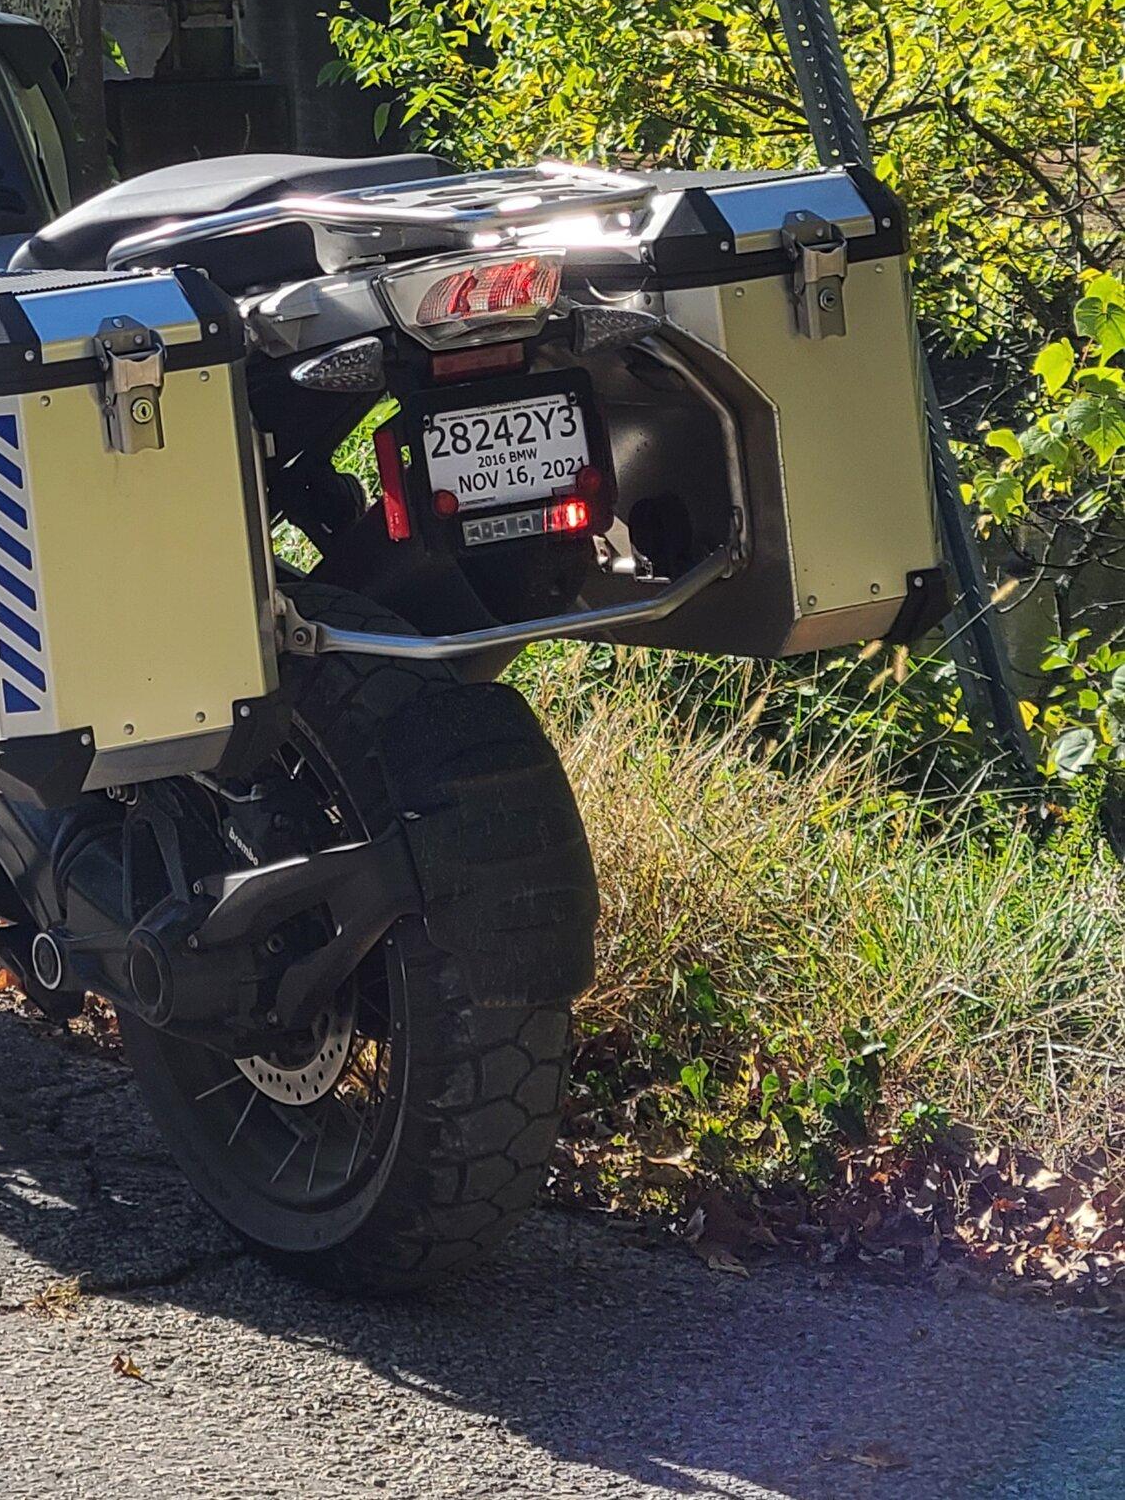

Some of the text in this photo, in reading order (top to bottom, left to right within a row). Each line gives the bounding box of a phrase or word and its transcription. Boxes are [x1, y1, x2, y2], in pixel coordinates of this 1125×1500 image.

[428, 405, 577, 459] 28242Y3
[458, 455, 585, 494] NOV 16, 2021
[477, 447, 538, 468] 2016 BMW
[228, 826, 259, 867] brembo
